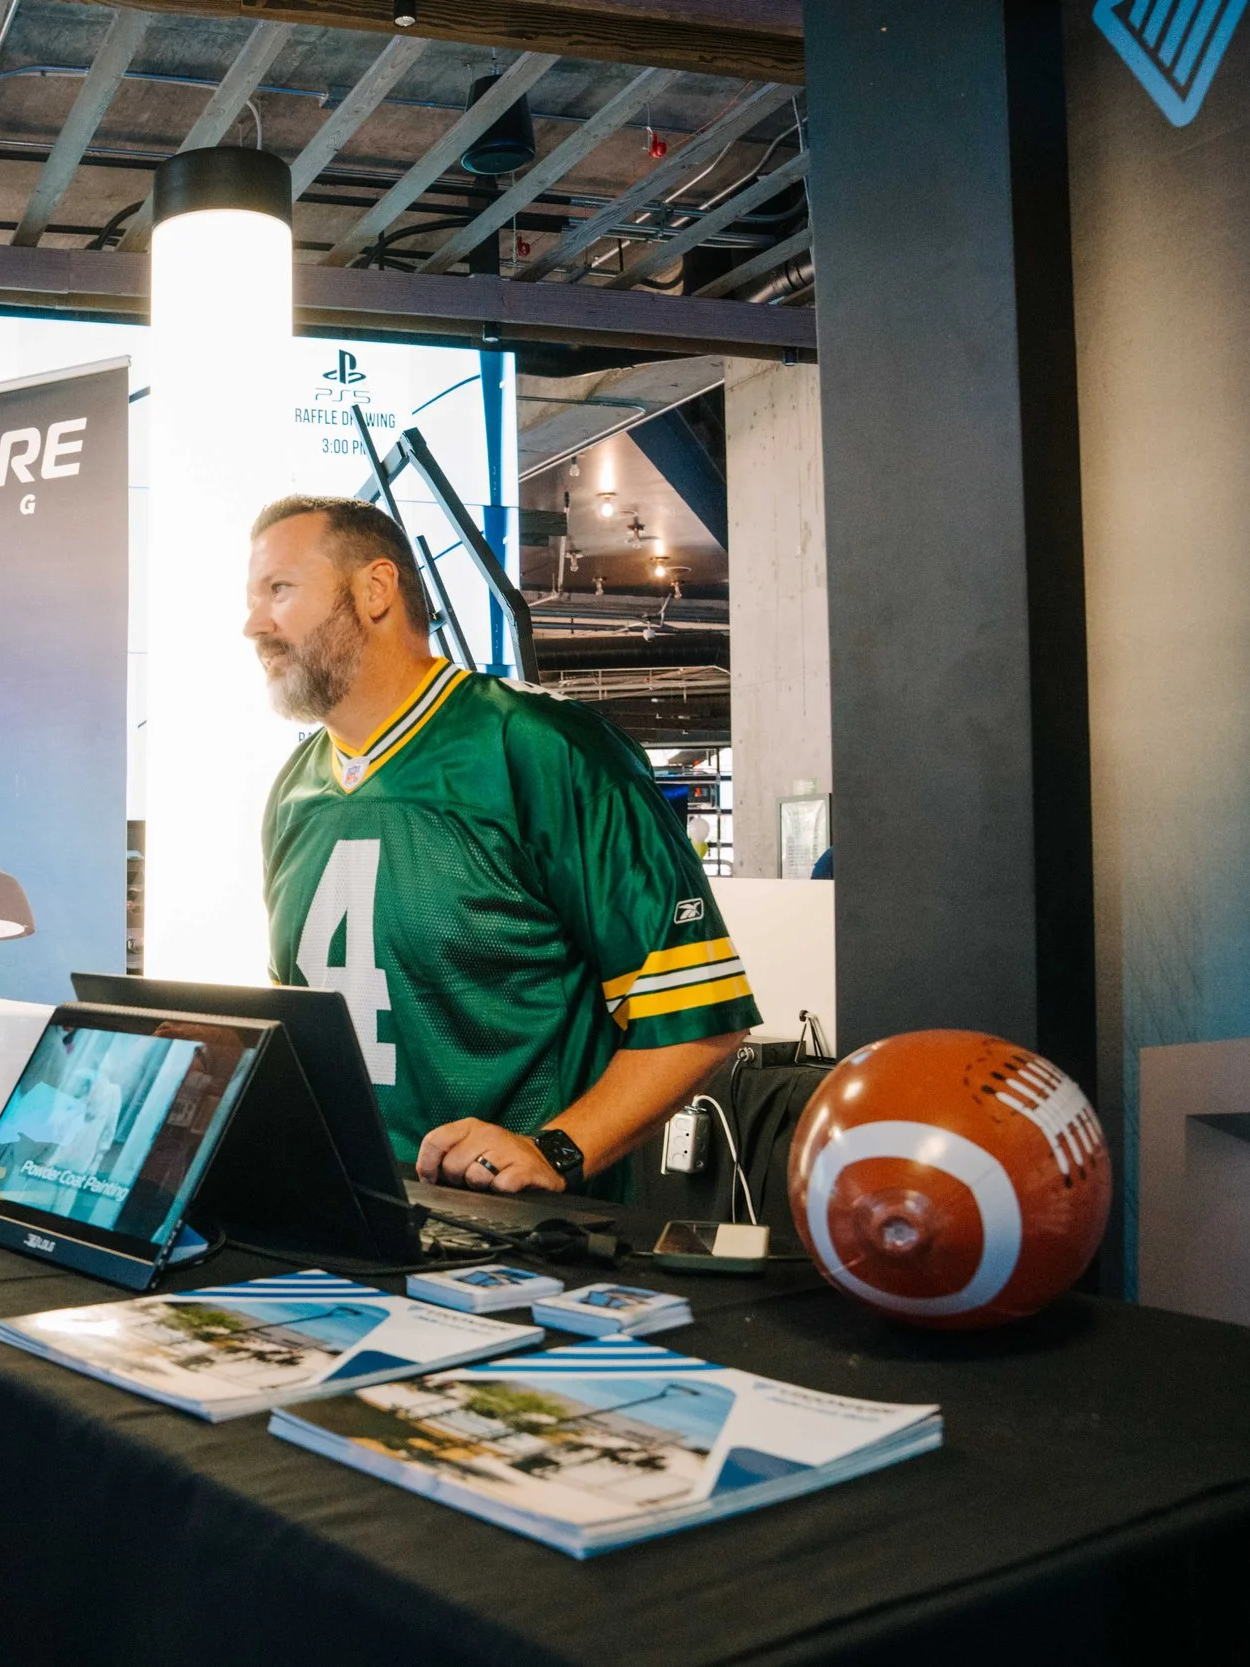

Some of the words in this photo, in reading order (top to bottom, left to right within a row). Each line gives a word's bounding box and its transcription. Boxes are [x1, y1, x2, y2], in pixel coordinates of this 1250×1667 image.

[295, 408, 338, 425] RAFFLE
[342, 411, 396, 428] DWING
[322, 438, 349, 454] 3:00
[296, 839, 398, 1087] 4
[20, 1159, 60, 1181] Powder
[59, 1169, 85, 1188] Coat
[83, 1176, 129, 1203] Painting
